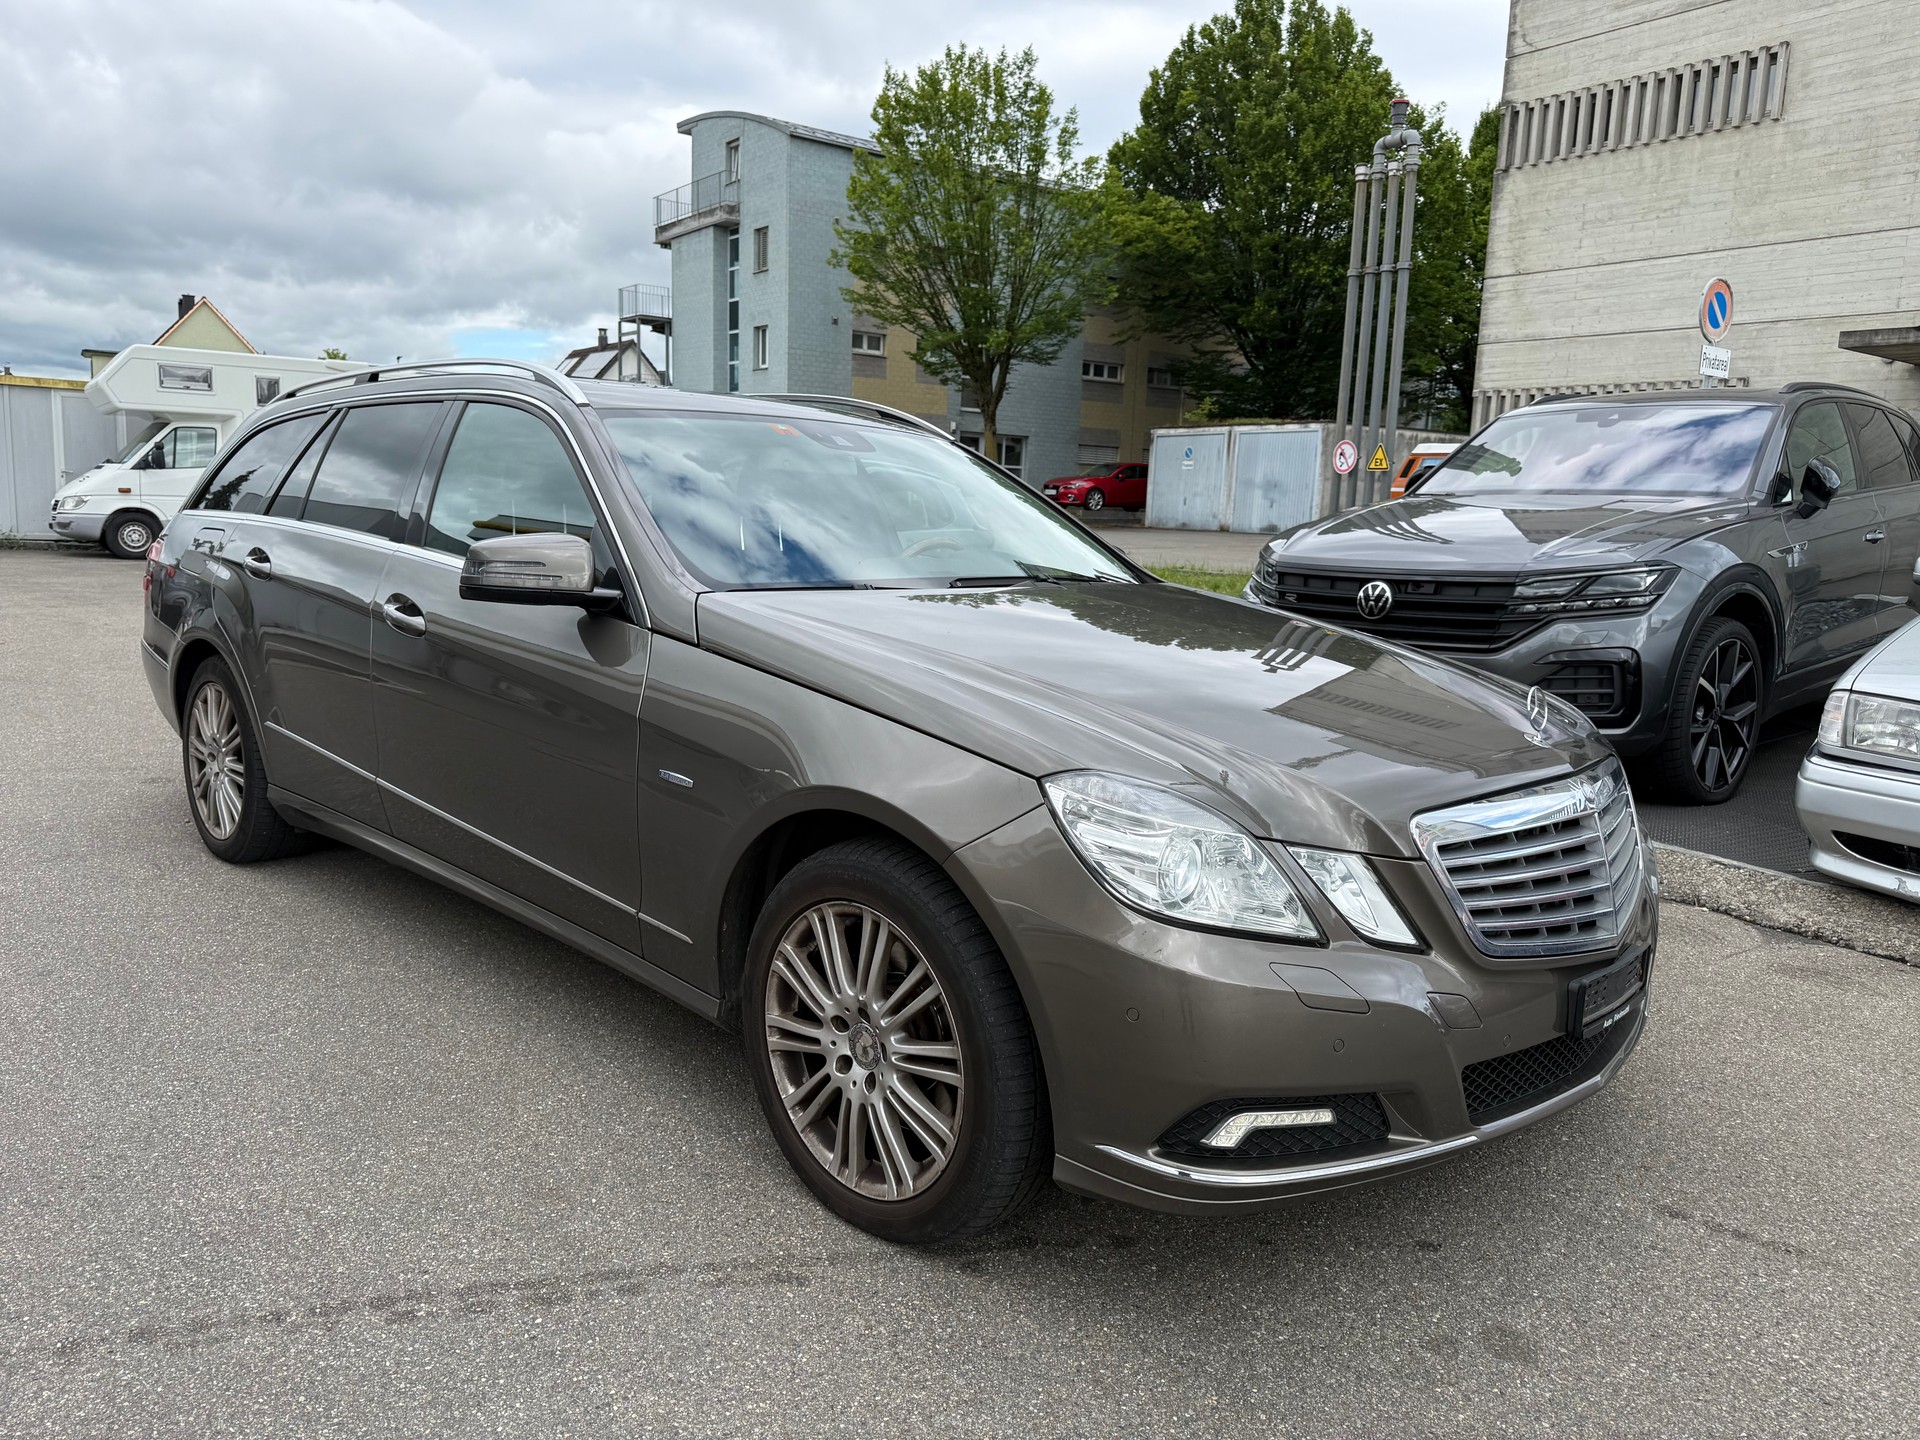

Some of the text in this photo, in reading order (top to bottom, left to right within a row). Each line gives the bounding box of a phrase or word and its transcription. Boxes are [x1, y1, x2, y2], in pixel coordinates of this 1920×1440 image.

[1701, 351, 1730, 372] Privatareal
[1374, 458, 1384, 467] EX
[1358, 582, 1391, 619] VW
